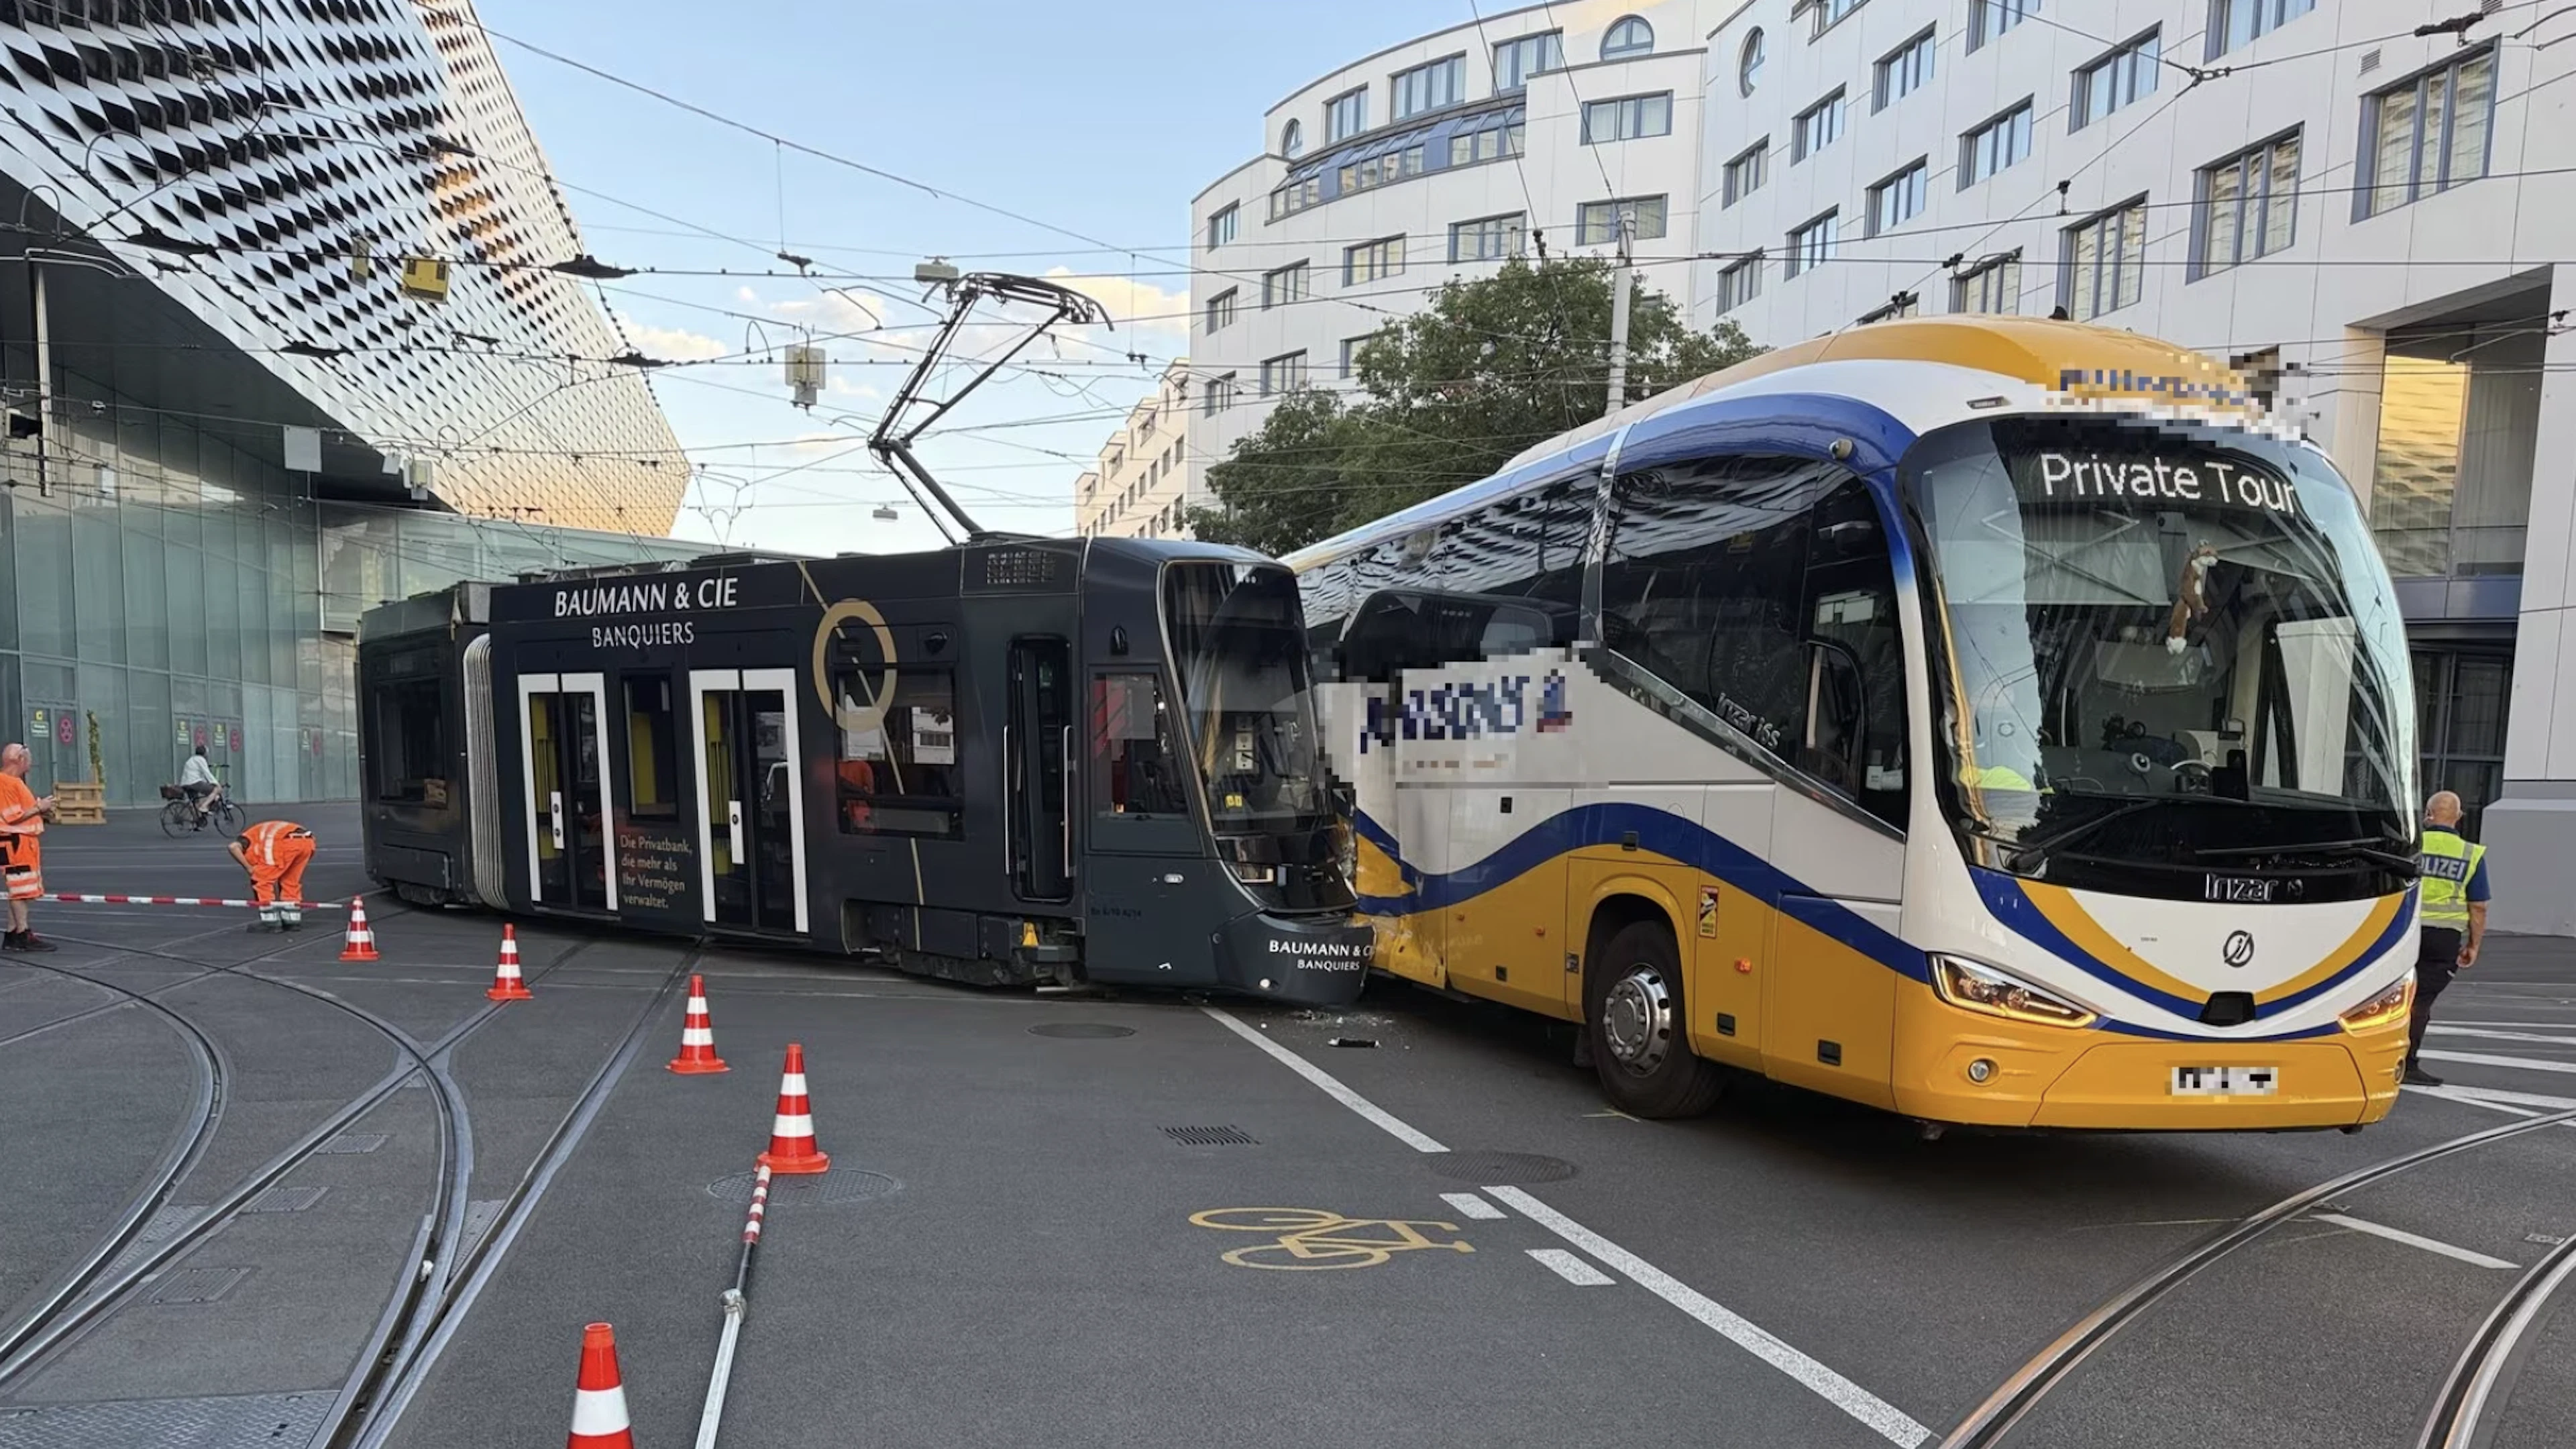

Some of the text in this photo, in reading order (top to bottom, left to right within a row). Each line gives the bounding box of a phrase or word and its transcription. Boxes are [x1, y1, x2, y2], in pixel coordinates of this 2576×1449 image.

[2040, 453, 2295, 514] Private Tour
[554, 577, 739, 617] BAUMANN & CIE
[592, 621, 695, 649] BANQUIERS
[619, 834, 693, 856] Die Privatbank,
[621, 853, 678, 871] die mehr als
[622, 872, 686, 895] Ihr Vermögen
[622, 893, 669, 909] verwaltet.
[1269, 940, 1350, 957] BAUMANN
[1352, 945, 1361, 957] &
[1297, 959, 1360, 972] BANQUIERS
